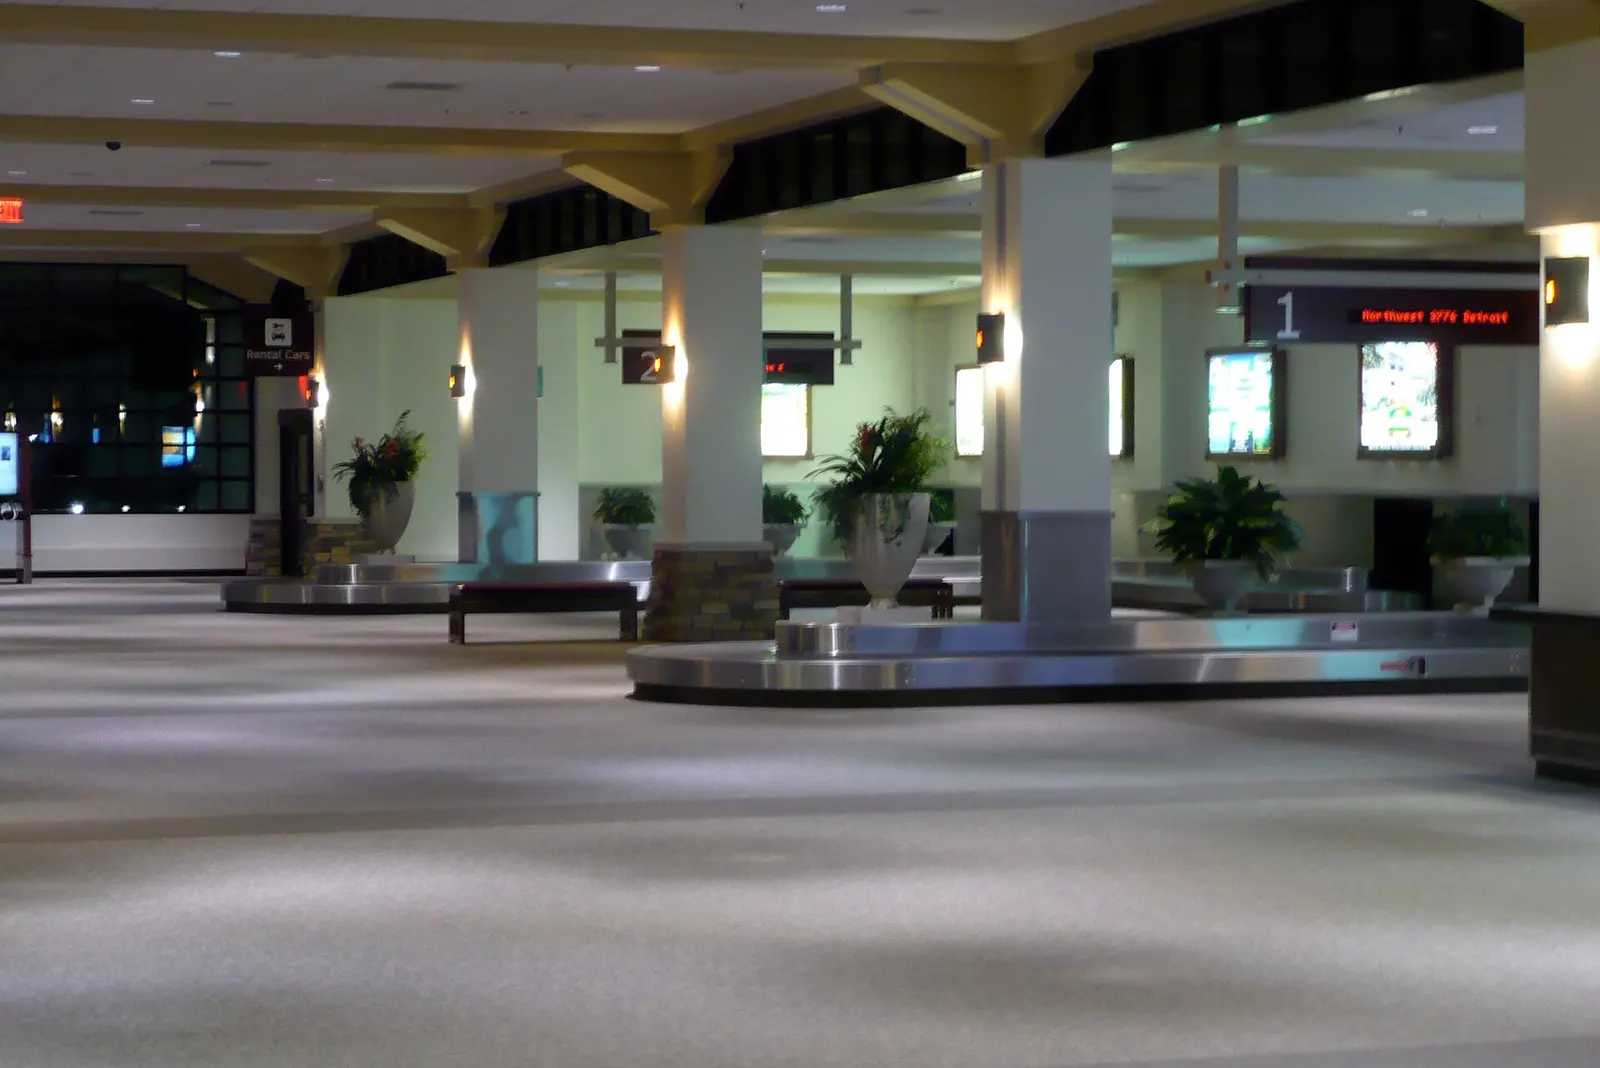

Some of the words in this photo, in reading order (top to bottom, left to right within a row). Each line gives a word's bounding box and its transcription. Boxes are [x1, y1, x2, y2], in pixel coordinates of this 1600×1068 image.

[1277, 292, 1300, 339] 1
[1361, 309, 1424, 323] Northwest
[1463, 309, 1509, 324] Detroit
[247, 350, 281, 359] Rental
[285, 350, 310, 359] Cars
[641, 351, 657, 381] 2
